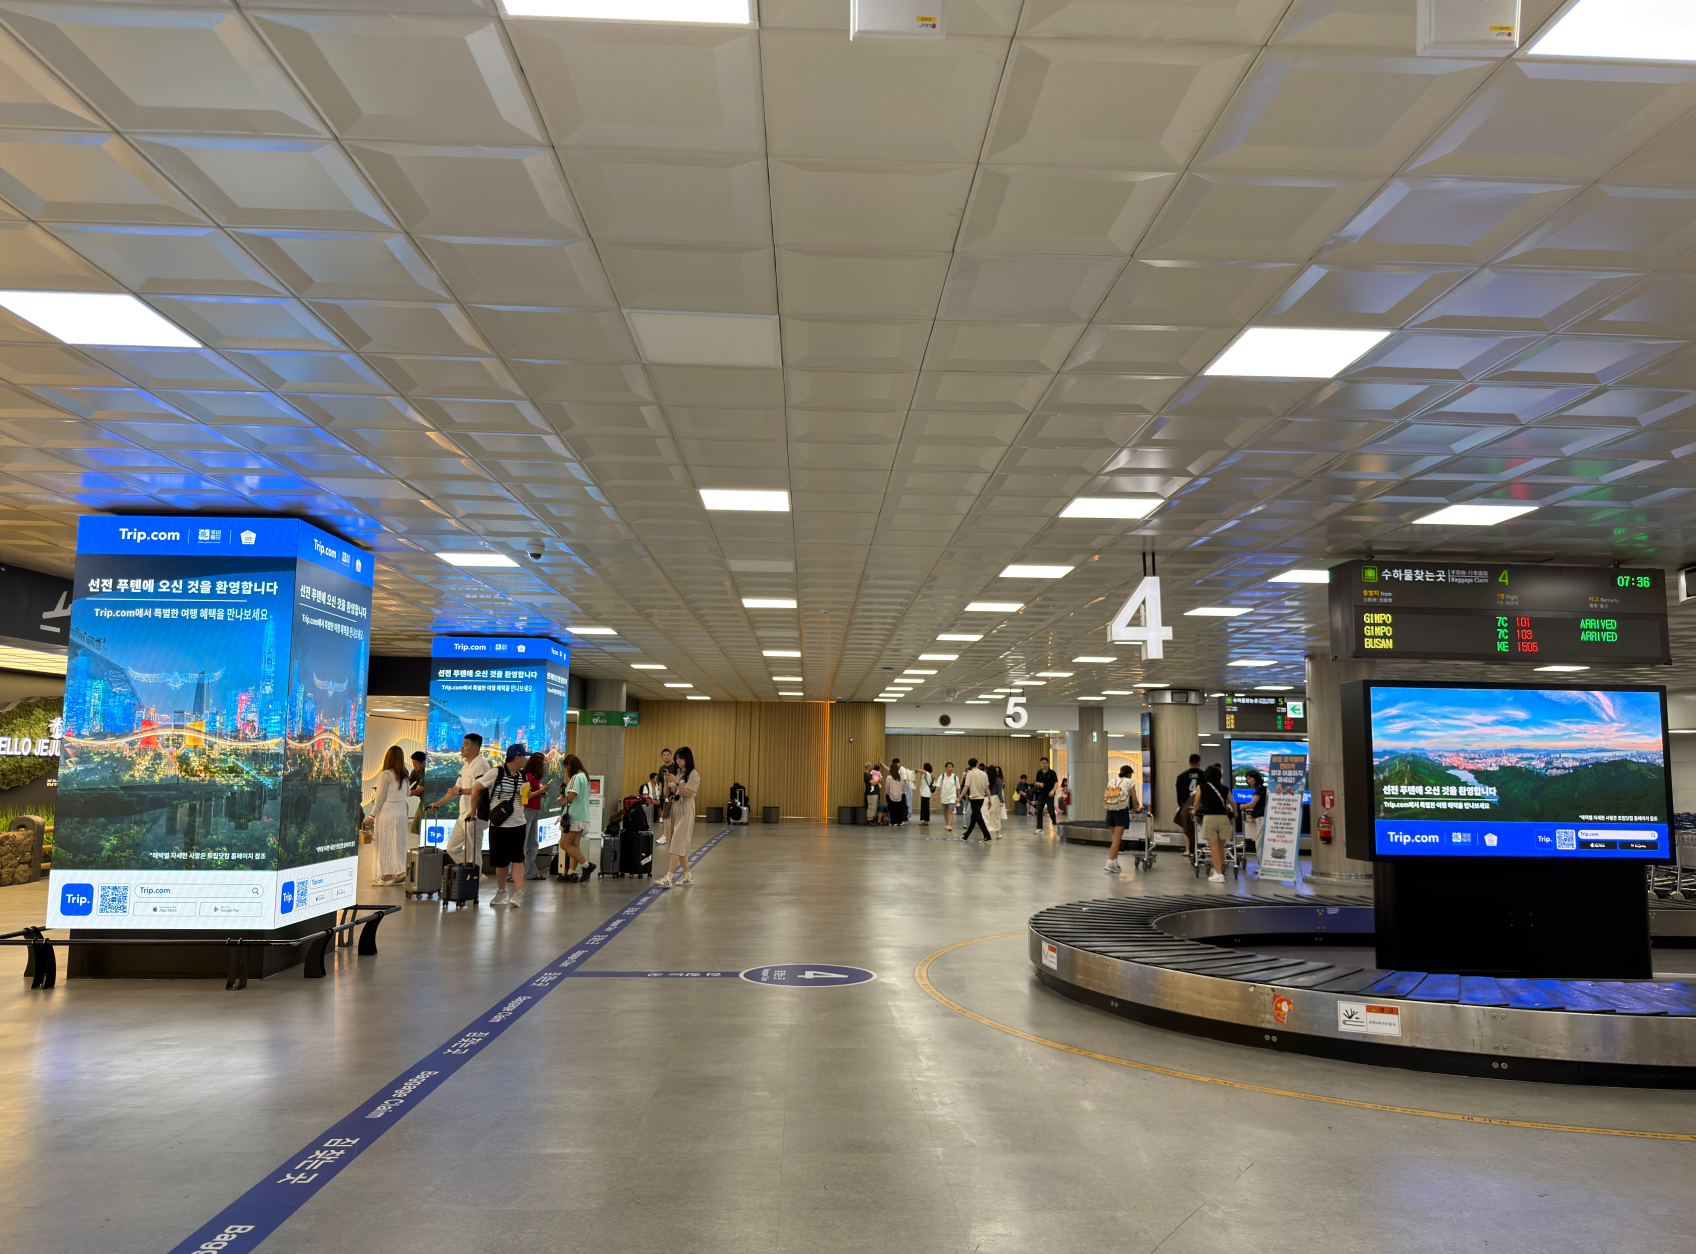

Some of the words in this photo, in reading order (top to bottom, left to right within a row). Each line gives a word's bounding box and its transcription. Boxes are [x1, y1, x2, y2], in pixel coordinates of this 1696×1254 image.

[119, 528, 180, 543] Trip.com
[313, 539, 337, 559] Trip.com
[1381, 569, 1446, 582] 수하물찾는곳
[1498, 569, 1509, 586] 4
[1616, 576, 1650, 588] 07:36
[88, 578, 113, 593] 선전
[117, 579, 155, 593] 푸톈에
[158, 579, 183, 594] 오신
[187, 580, 212, 594] 것을
[215, 580, 279, 595] 환영합니다
[300, 584, 311, 599] 선전
[326, 594, 337, 608] 오신
[337, 597, 347, 612] 것을
[94, 608, 152, 619] Trip.com에서
[154, 608, 179, 619] 특별한
[181, 608, 198, 620] 여행
[199, 608, 225, 620] 혜택을
[1110, 576, 1173, 660] 4
[1363, 613, 1392, 624] GIMPO
[1496, 616, 1508, 627] 7C
[1516, 617, 1530, 628] 101
[1580, 618, 1617, 630] ARRIVED
[1363, 625, 1392, 636] GIMPO
[1496, 628, 1509, 640] 7C
[1516, 629, 1533, 640] 103
[1580, 631, 1618, 642] ARRIVED
[453, 643, 487, 652] Trip.com
[1364, 637, 1393, 649] BUSAN
[1497, 641, 1509, 652] KE
[437, 669, 452, 678] 선전
[474, 670, 488, 678] 오신
[489, 670, 503, 678] 것을
[504, 670, 538, 679] 환영합니다
[1005, 697, 1028, 728] 5
[1383, 785, 1399, 795] 선전
[1424, 785, 1440, 796] 오신
[1441, 786, 1457, 796] 것을
[1458, 786, 1497, 796] 환영합니다
[1383, 801, 1420, 809] Trip.com에서
[1387, 831, 1439, 845] Trip.com
[1537, 835, 1553, 843] Trip.
[139, 886, 171, 895] Trip.com
[283, 891, 294, 904] Trip.
[65, 893, 91, 906] Trip.
[797, 970, 848, 979] 4
[502, 995, 532, 1012] Baggage
[488, 1011, 513, 1023] Claim
[392, 1070, 439, 1099] Baggage
[364, 1098, 405, 1119] Claim
